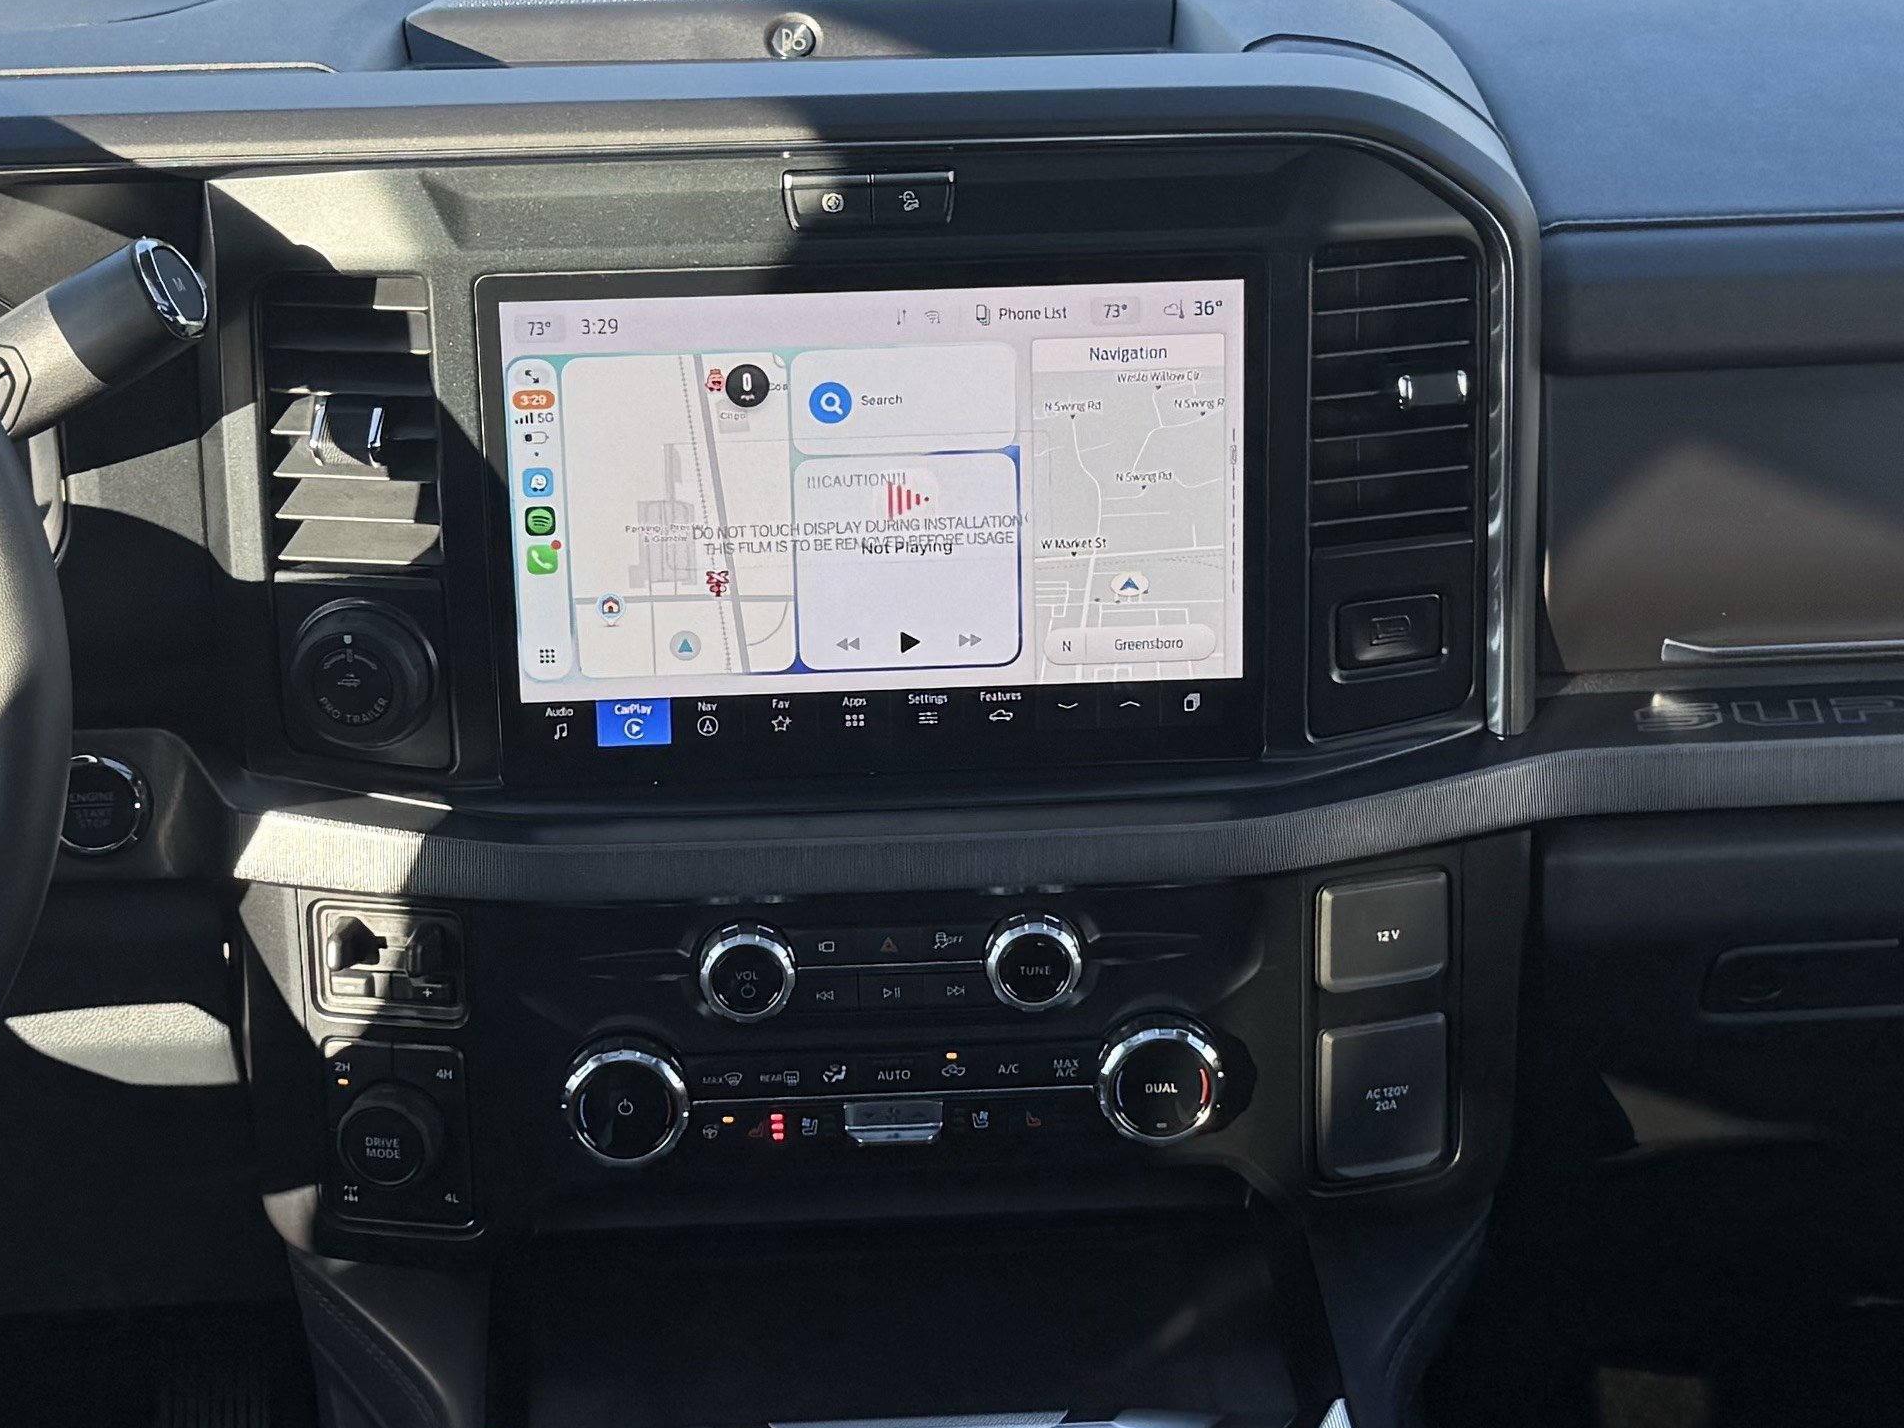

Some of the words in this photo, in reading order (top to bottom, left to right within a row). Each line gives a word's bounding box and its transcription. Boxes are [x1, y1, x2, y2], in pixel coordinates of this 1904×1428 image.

[999, 307, 1041, 320] Phone
[1044, 306, 1067, 319] List
[1104, 304, 1128, 318] 73°
[1194, 300, 1223, 316] 36°
[527, 321, 551, 336] 73°
[581, 318, 619, 335] 3:29
[1089, 346, 1168, 363] Navigation
[742, 372, 752, 391] 0
[520, 394, 547, 406] 3:29
[861, 394, 903, 407] Search
[537, 412, 554, 423] 5G
[1125, 472, 1156, 483] Swing
[693, 527, 714, 540] DO
[718, 525, 746, 539] NOT
[750, 523, 799, 538] TOUCH
[803, 521, 862, 536] DISPLAY
[865, 518, 920, 533] DURING
[924, 514, 1022, 530] INSTALLATION
[703, 542, 735, 556] THIS
[739, 540, 772, 553] FILM
[776, 540, 788, 553] IS
[791, 539, 810, 552] TO
[814, 538, 832, 551] BE
[909, 532, 964, 547] BEFORE
[966, 531, 1014, 545] USAGE
[862, 540, 890, 555] Not
[895, 540, 953, 556] Playing
[1041, 540, 1054, 550] W
[1055, 538, 1093, 550] Market
[1095, 537, 1107, 548] St
[1062, 641, 1072, 652] N
[1114, 638, 1184, 651] Greensboro
[842, 696, 867, 708] Apps
[908, 694, 948, 706] Settings
[980, 691, 1022, 702] Features
[319, 695, 341, 720] PRO
[345, 696, 389, 725] TRAILER
[614, 703, 653, 715] CarPlay
[698, 702, 717, 712] Nav
[772, 699, 790, 709] Fav
[545, 707, 574, 717] Audio
[1377, 930, 1390, 943] 12
[735, 971, 759, 982] VOL
[1020, 965, 1051, 976] TUNE
[334, 1061, 350, 1072] 2H
[998, 1063, 1020, 1075] A/C
[1053, 1058, 1080, 1069] MAX
[436, 1069, 453, 1080] 4H
[877, 1069, 911, 1082] AUTO
[1056, 1067, 1077, 1078] A/C
[1145, 1082, 1178, 1094] DUAL
[1366, 1088, 1381, 1100] AC
[1383, 1085, 1409, 1098] 120V
[1375, 1100, 1397, 1112] 20A
[365, 1136, 400, 1148] DRIVE
[366, 1148, 401, 1160] MODE
[445, 1193, 459, 1204] 4L
